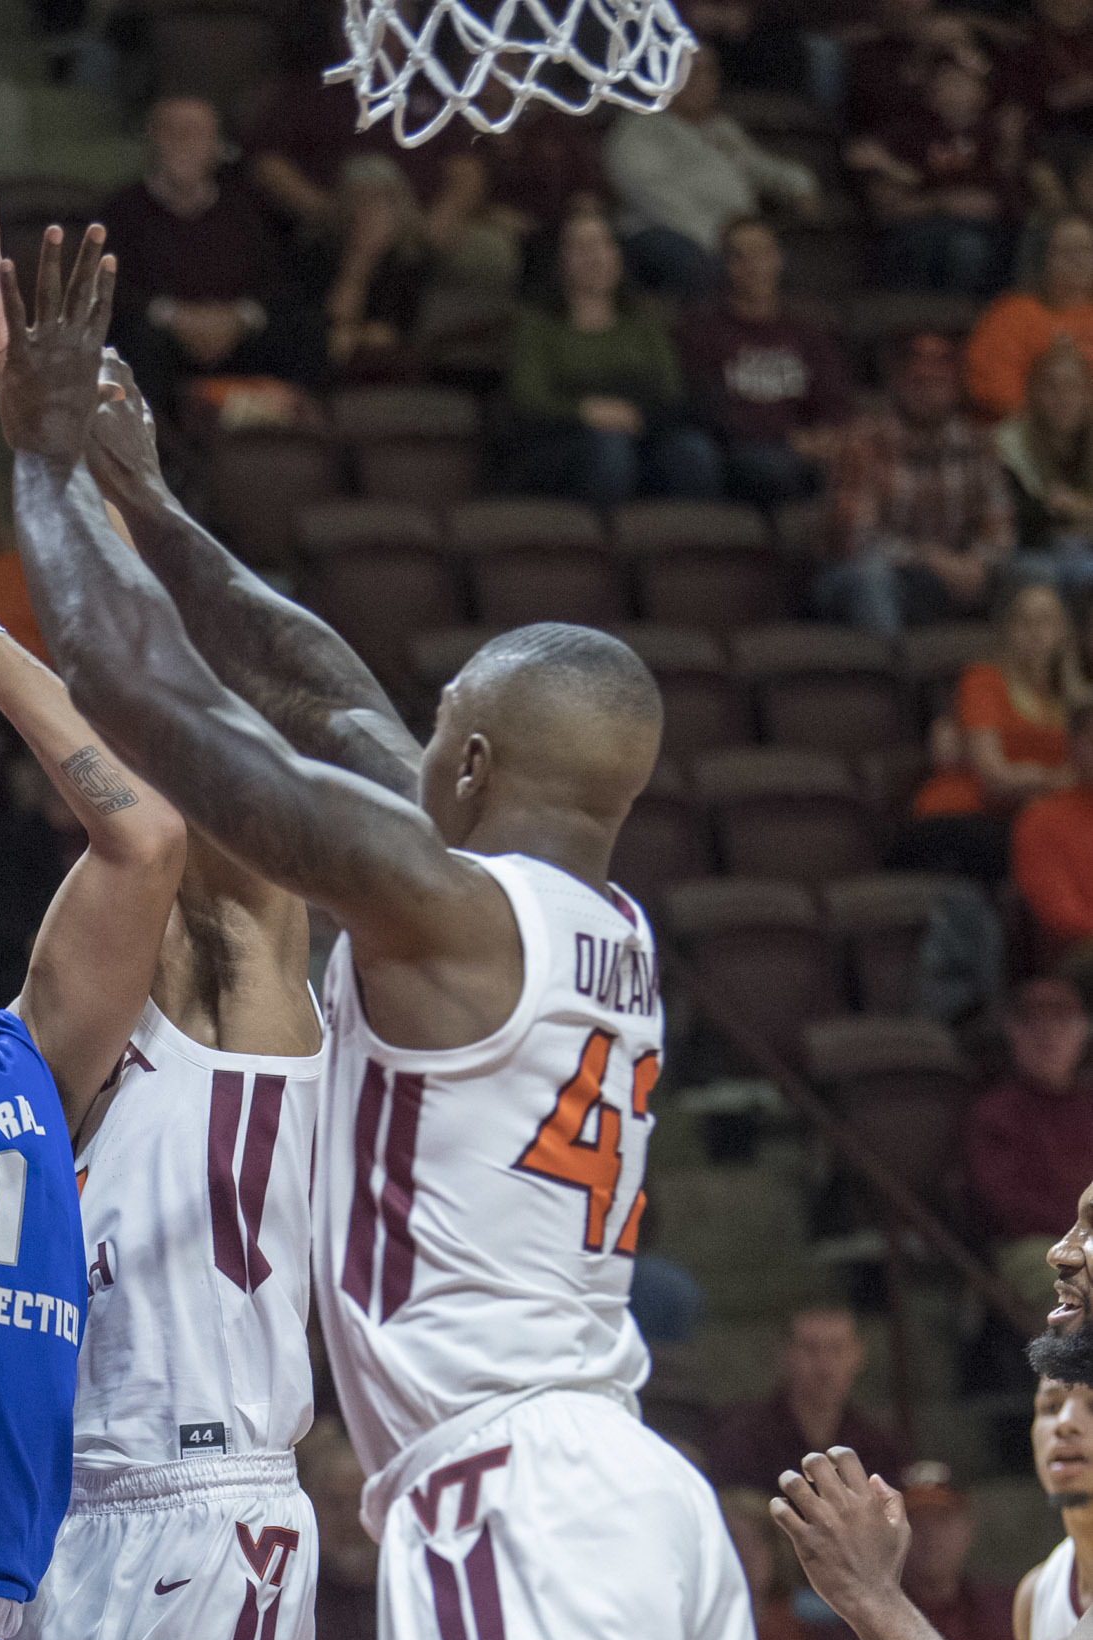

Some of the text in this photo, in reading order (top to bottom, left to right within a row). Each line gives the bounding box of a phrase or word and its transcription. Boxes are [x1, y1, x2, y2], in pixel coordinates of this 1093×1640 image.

[189, 1429, 214, 1443] 44
[407, 1445, 512, 1537] VT
[235, 1521, 300, 1587] VT
